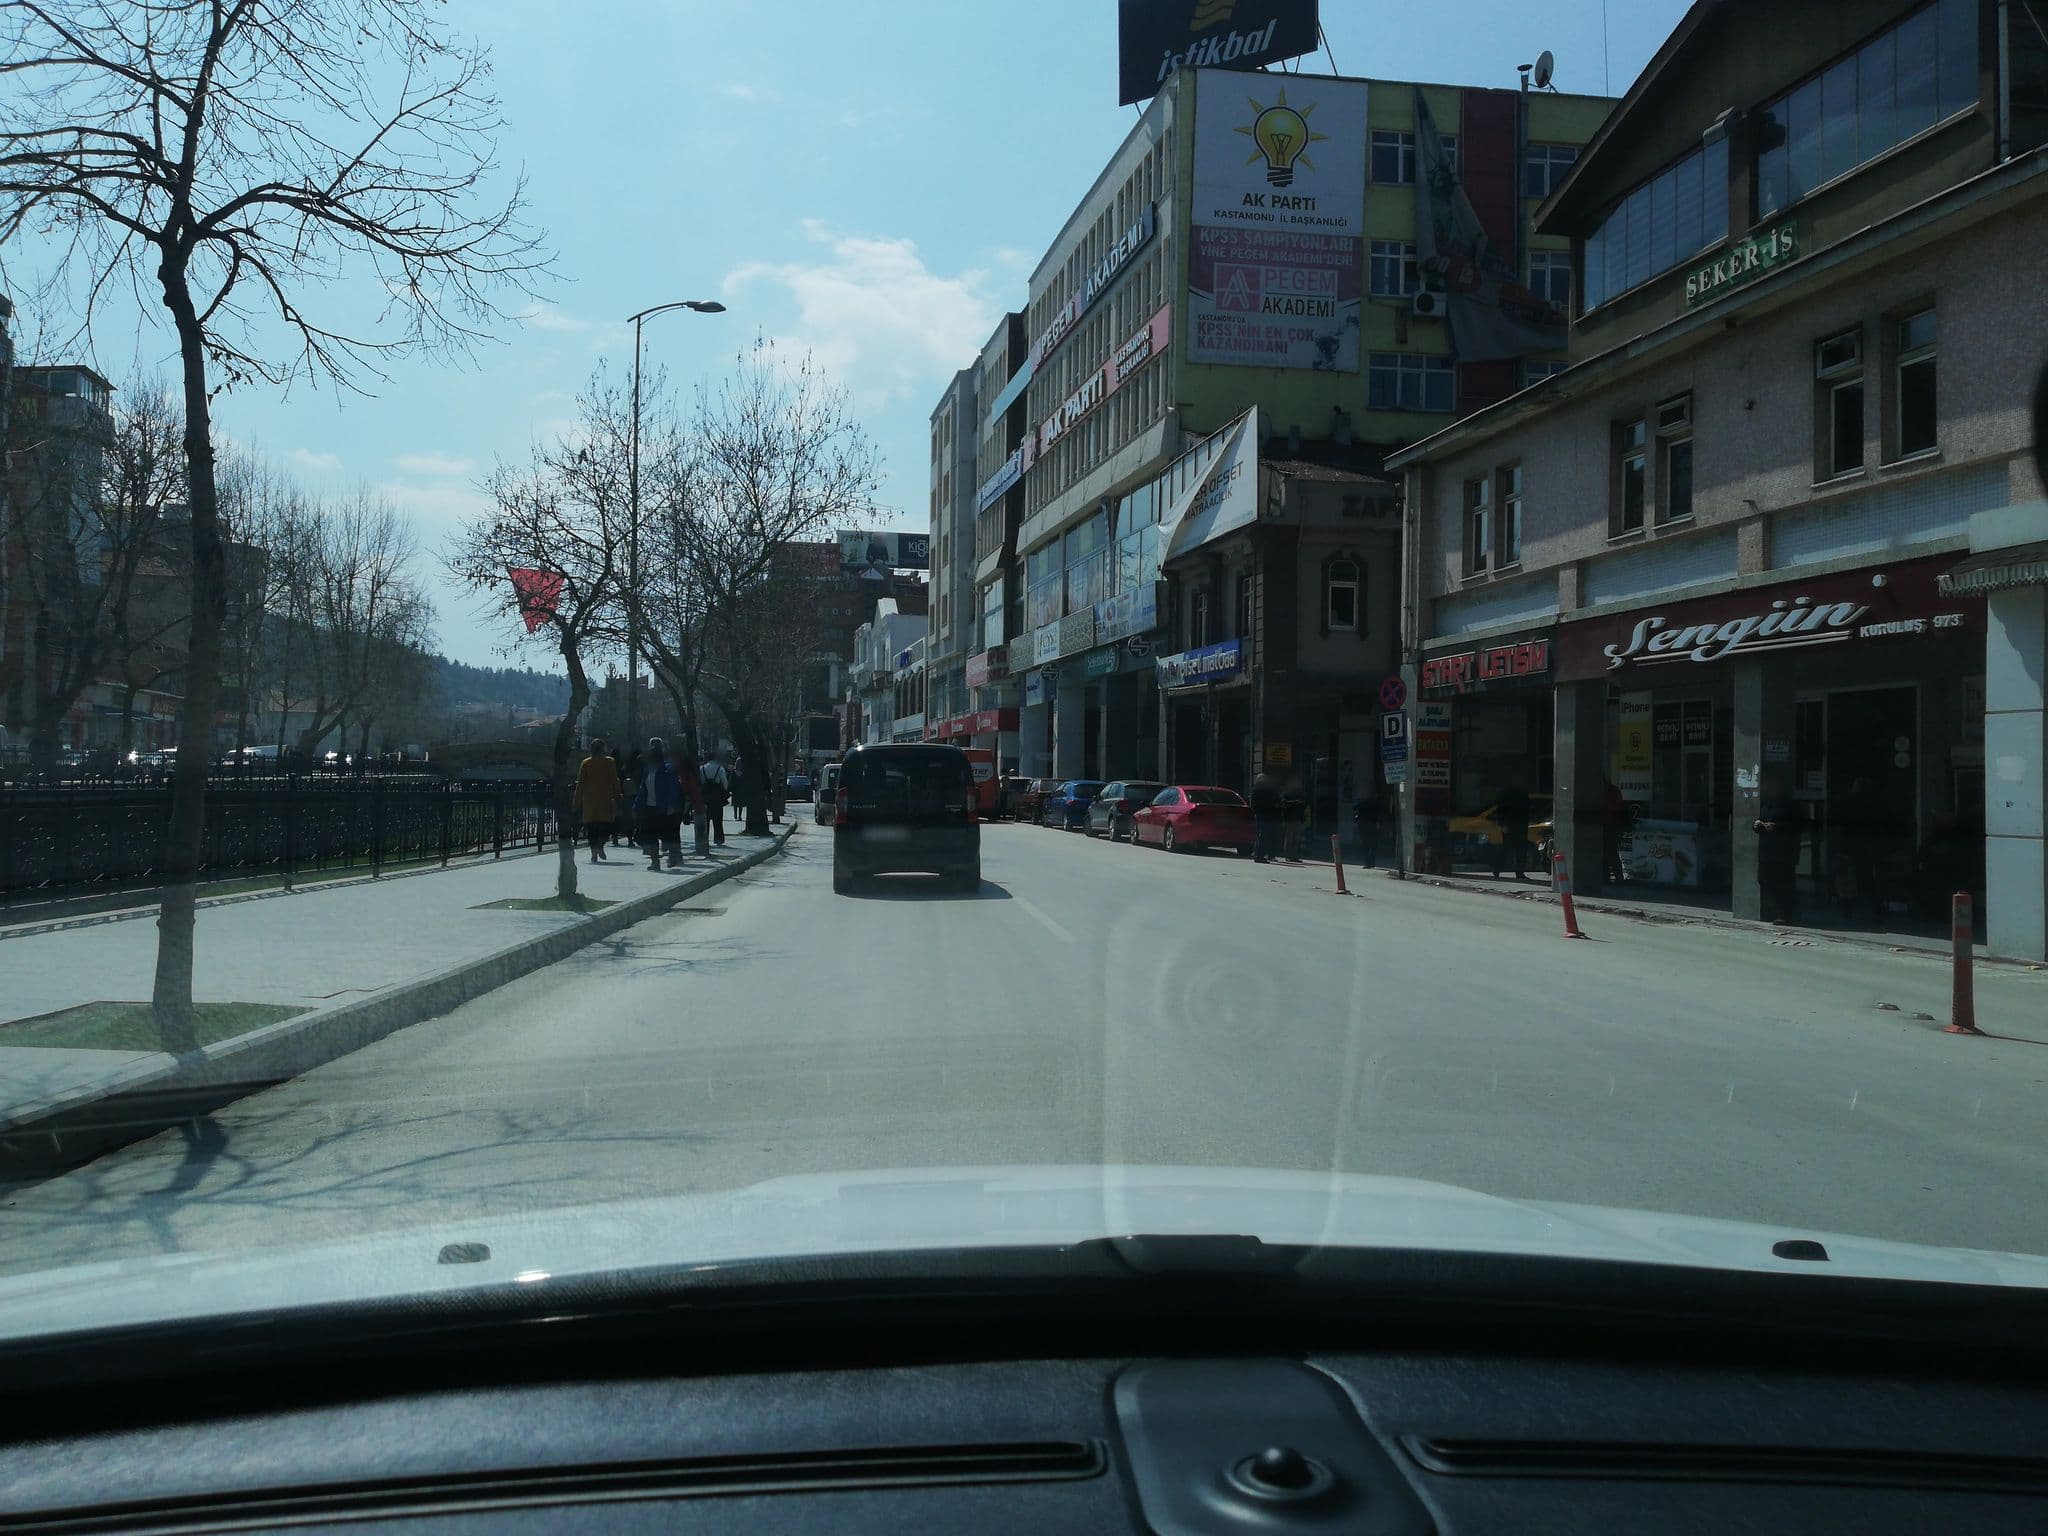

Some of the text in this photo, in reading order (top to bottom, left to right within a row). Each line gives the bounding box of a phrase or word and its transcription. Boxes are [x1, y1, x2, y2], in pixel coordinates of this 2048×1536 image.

[1242, 192, 1265, 207] AK
[1214, 209, 1275, 222] KASTAMONU
[1265, 270, 1335, 292] PEGEM
[1262, 295, 1335, 318] AKADEMİ
[1604, 596, 1870, 670] Şengün
[1620, 701, 1650, 714] iPhone
[1387, 716, 1400, 736] D
